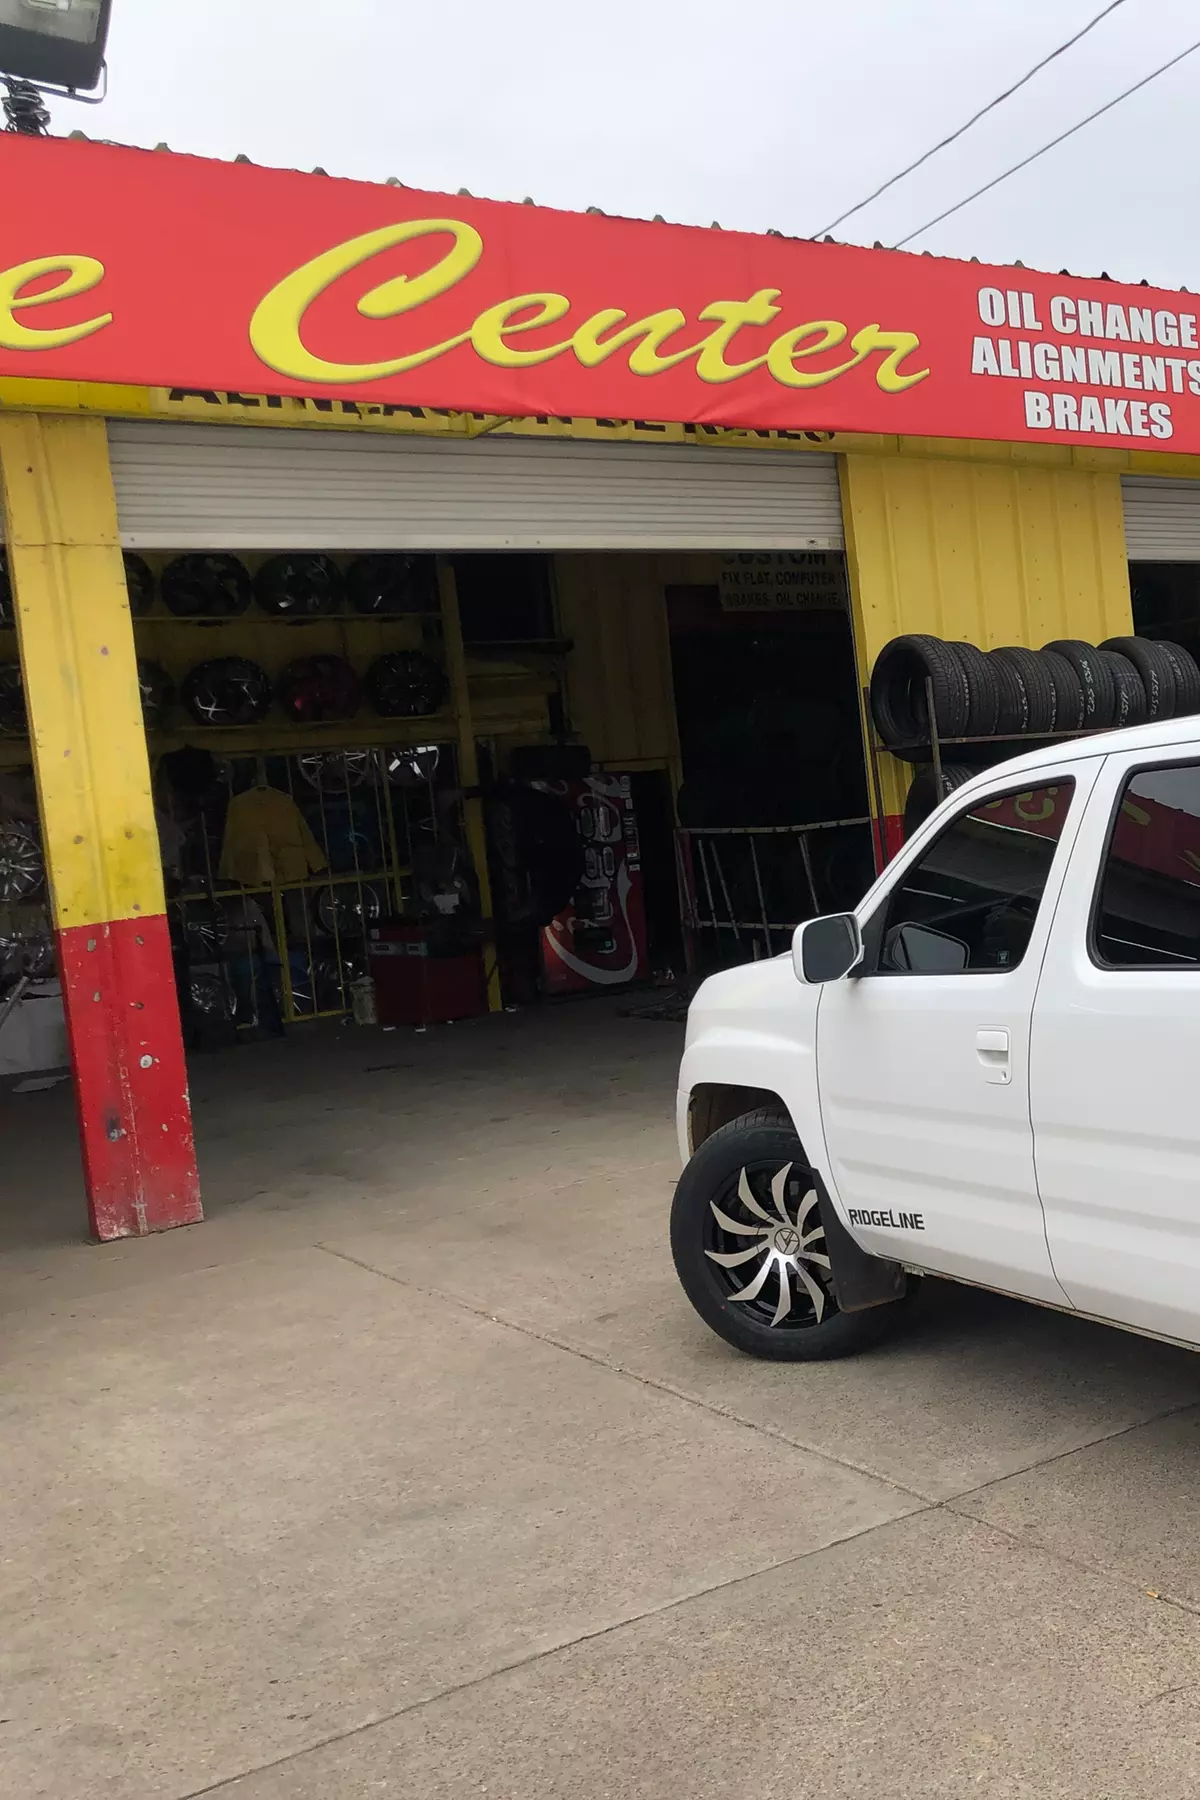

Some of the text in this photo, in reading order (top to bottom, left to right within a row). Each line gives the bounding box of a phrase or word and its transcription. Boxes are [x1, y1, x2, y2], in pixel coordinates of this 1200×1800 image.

[249, 218, 930, 391] Center
[977, 286, 1200, 350] OIL CHANGE
[1024, 391, 1174, 439] BRAKES
[775, 571, 836, 586] COMPUTER
[847, 1208, 926, 1231] RIDGELINE
